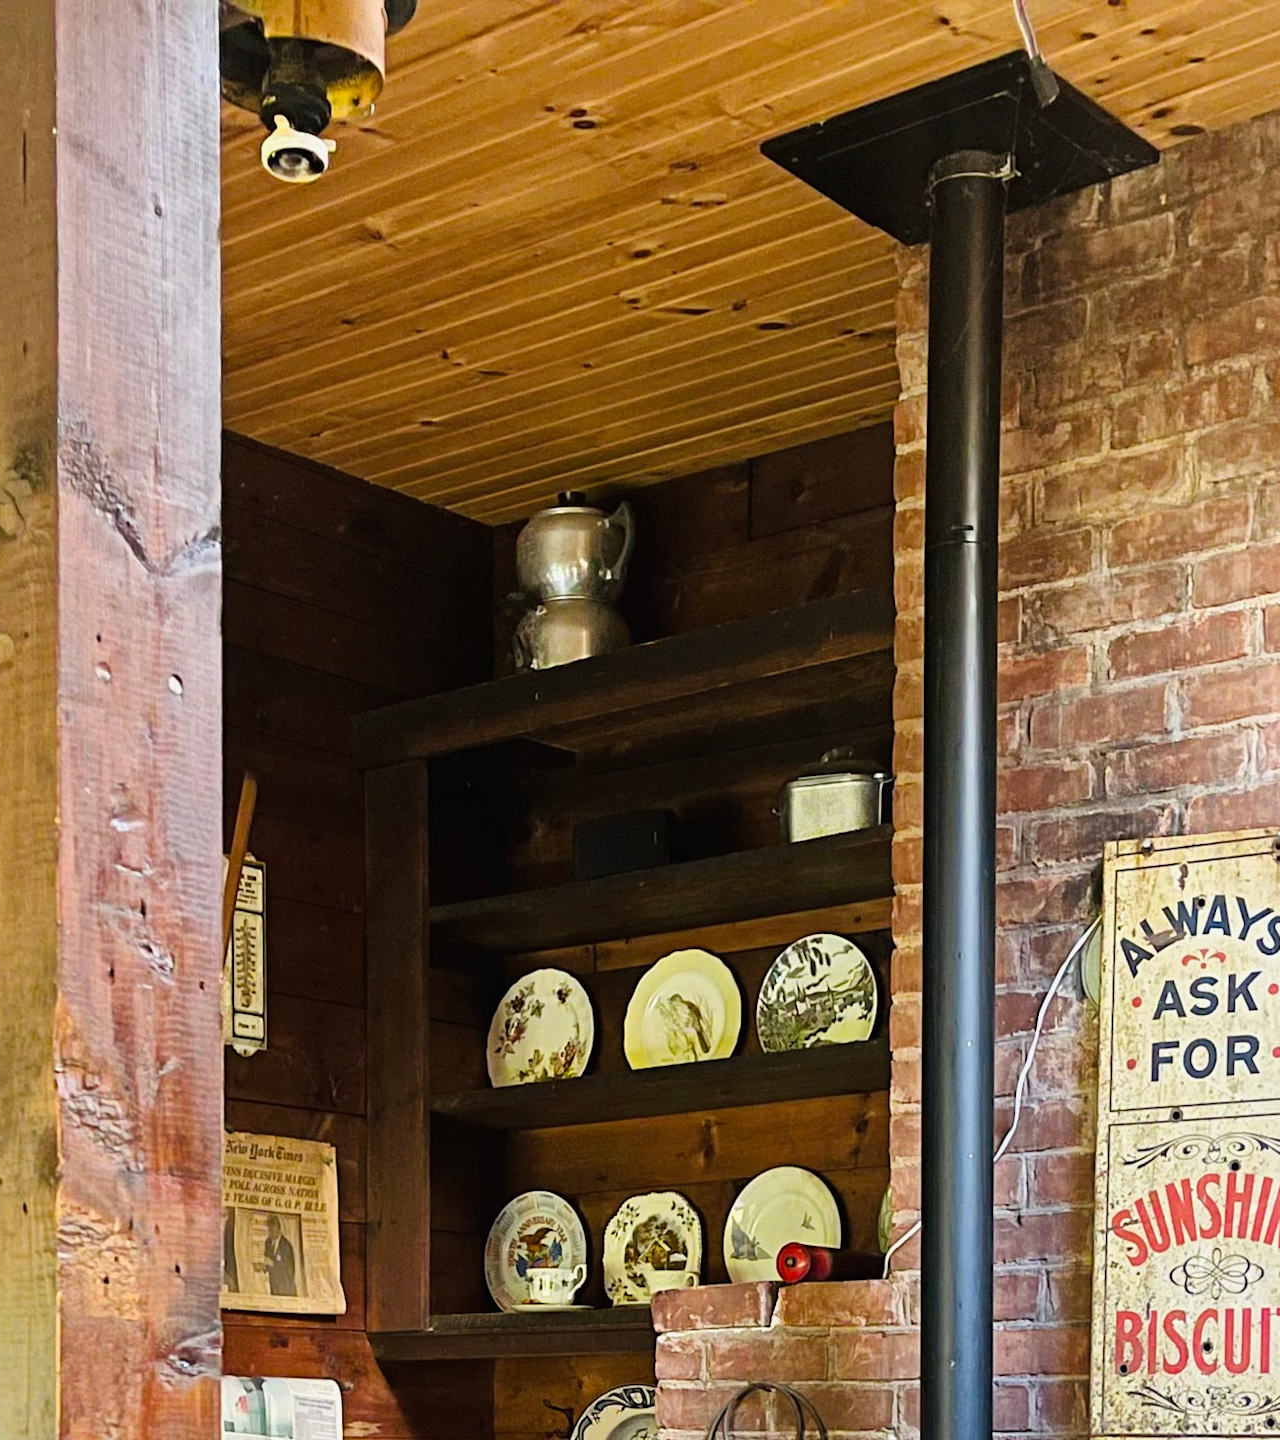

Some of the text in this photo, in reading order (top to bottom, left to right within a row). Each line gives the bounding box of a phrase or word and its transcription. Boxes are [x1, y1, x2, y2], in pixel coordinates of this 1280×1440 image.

[1152, 971, 1261, 1019] ASK
[1150, 1036, 1260, 1082] FOR
[249, 1143, 275, 1160] York
[276, 1146, 303, 1162] Times
[242, 1168, 283, 1182] DECISIVE
[229, 1179, 251, 1191] POLL
[253, 1183, 286, 1196] ACROSS
[289, 1187, 320, 1200] NATION
[233, 1193, 259, 1206] YEARS
[261, 1196, 272, 1207] OF
